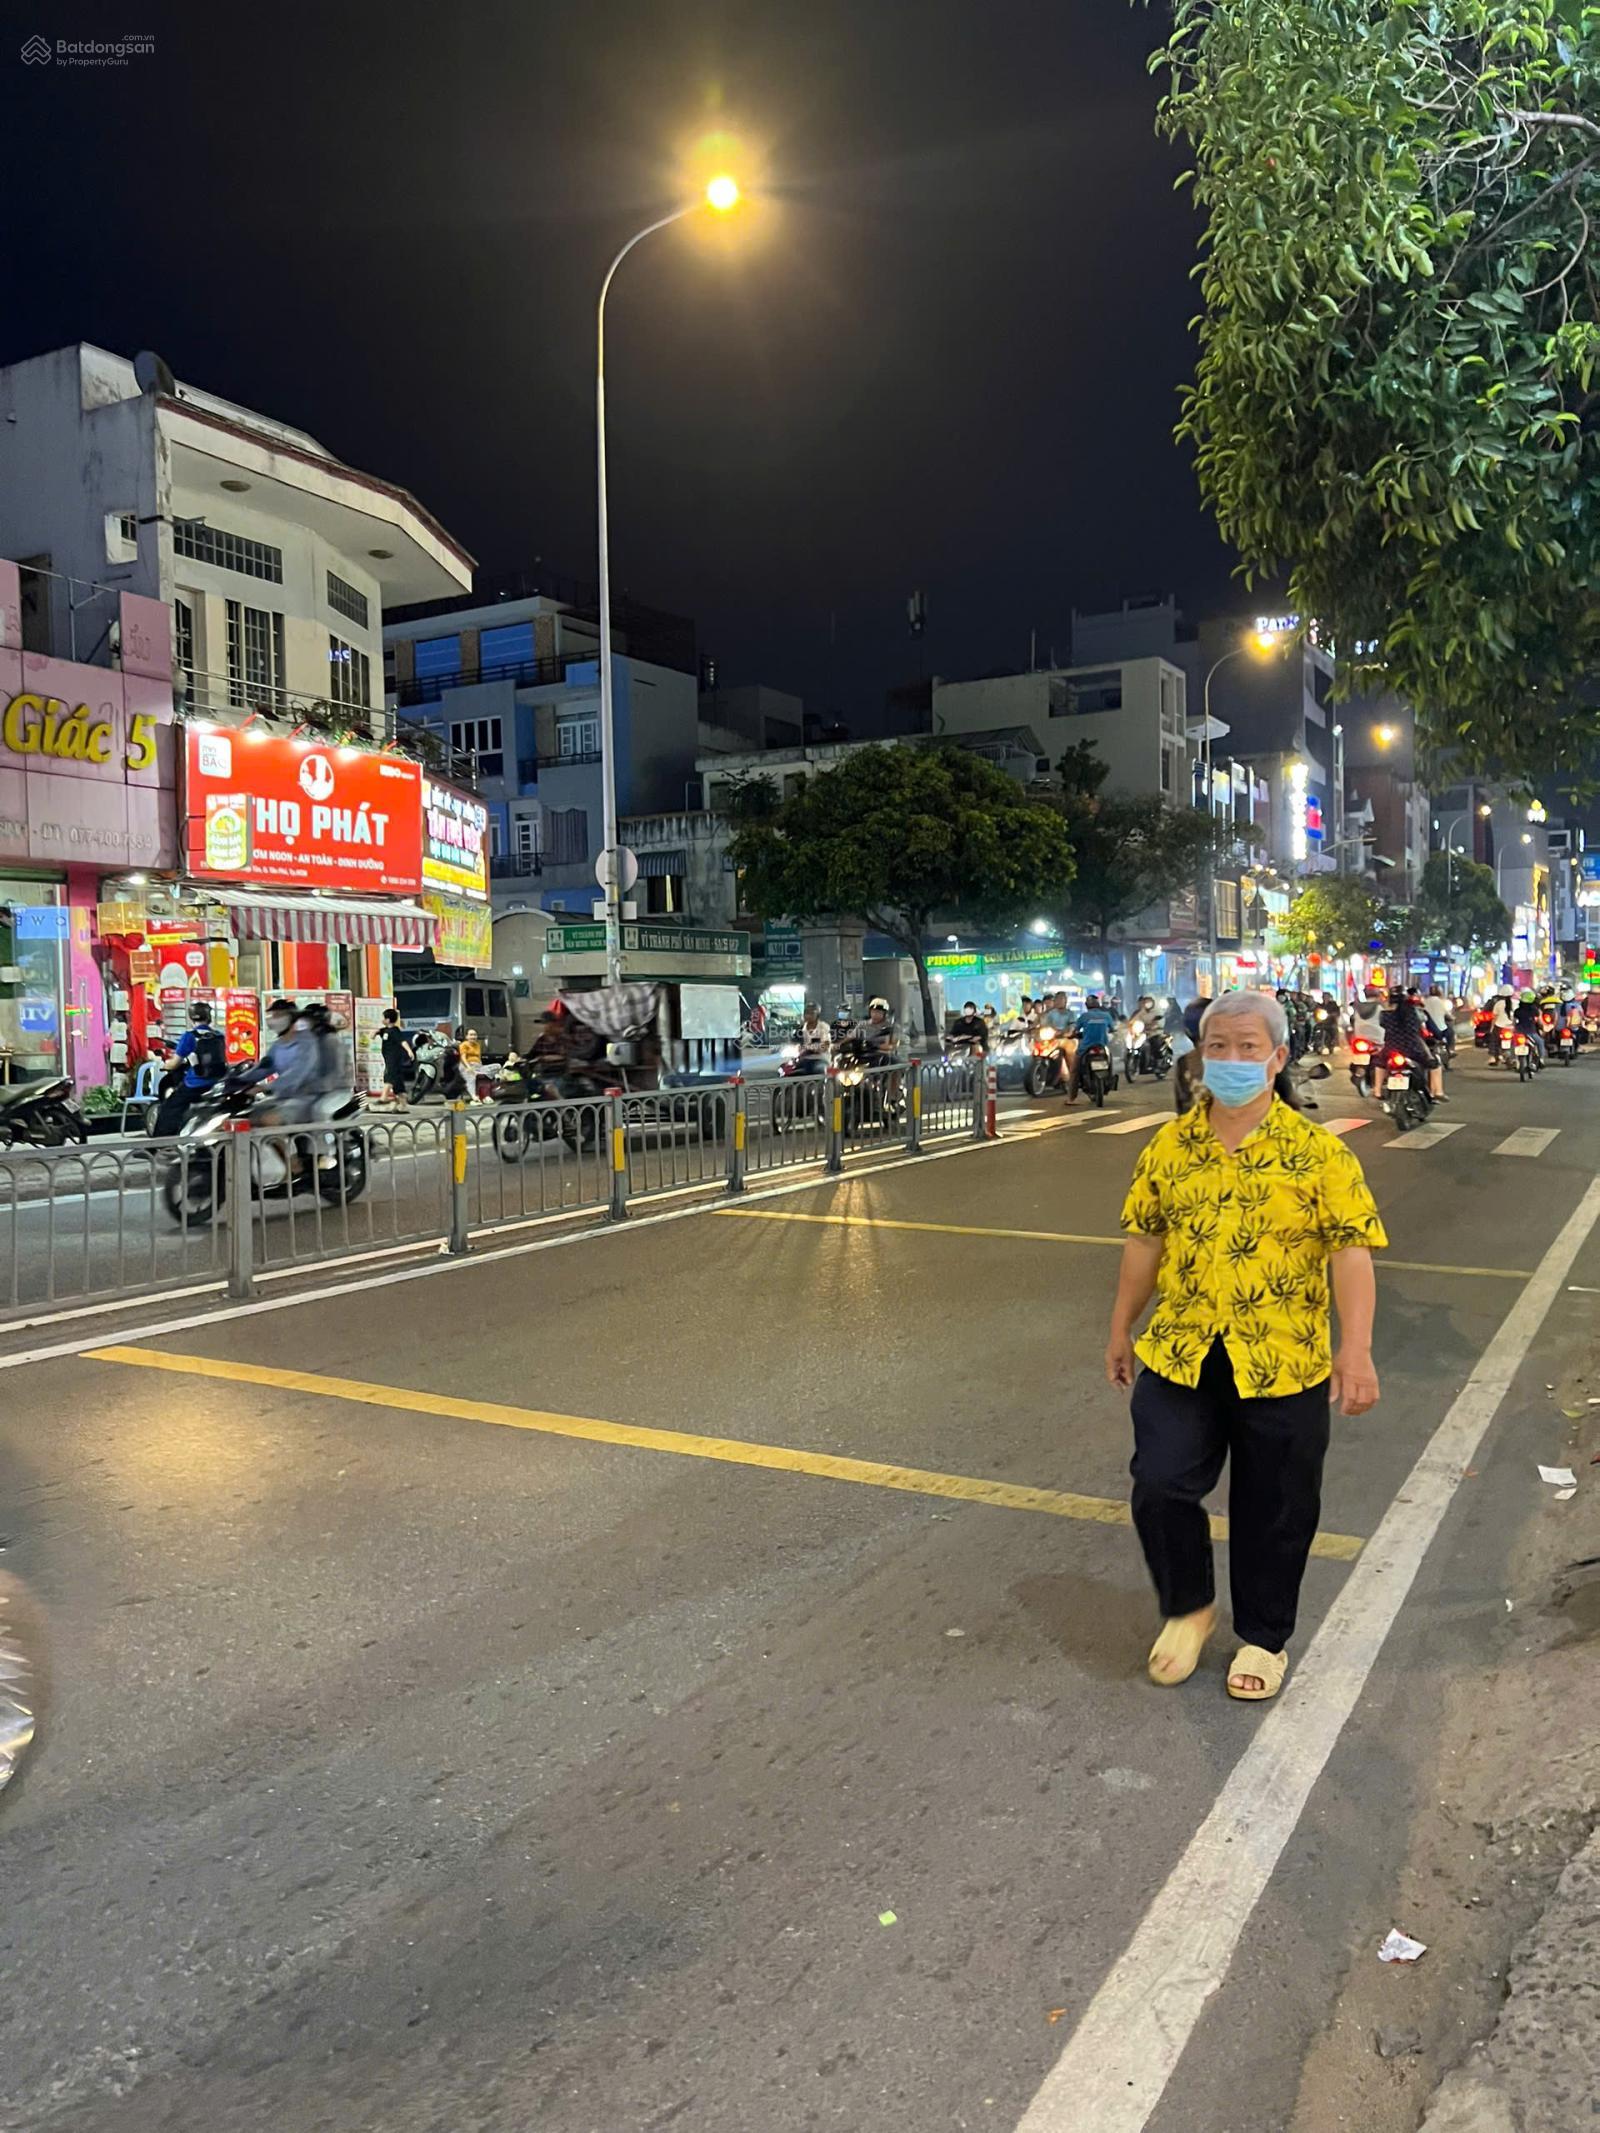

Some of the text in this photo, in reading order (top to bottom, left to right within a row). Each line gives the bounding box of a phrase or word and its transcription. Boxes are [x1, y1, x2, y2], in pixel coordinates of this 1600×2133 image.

[3, 692, 158, 770] Giác 5
[252, 797, 300, 846] HỌ
[312, 802, 389, 846] PHÁT
[252, 849, 268, 861] ƠM
[268, 851, 294, 863] NGON
[298, 853, 311, 864] AN
[311, 852, 333, 866] TOÀN
